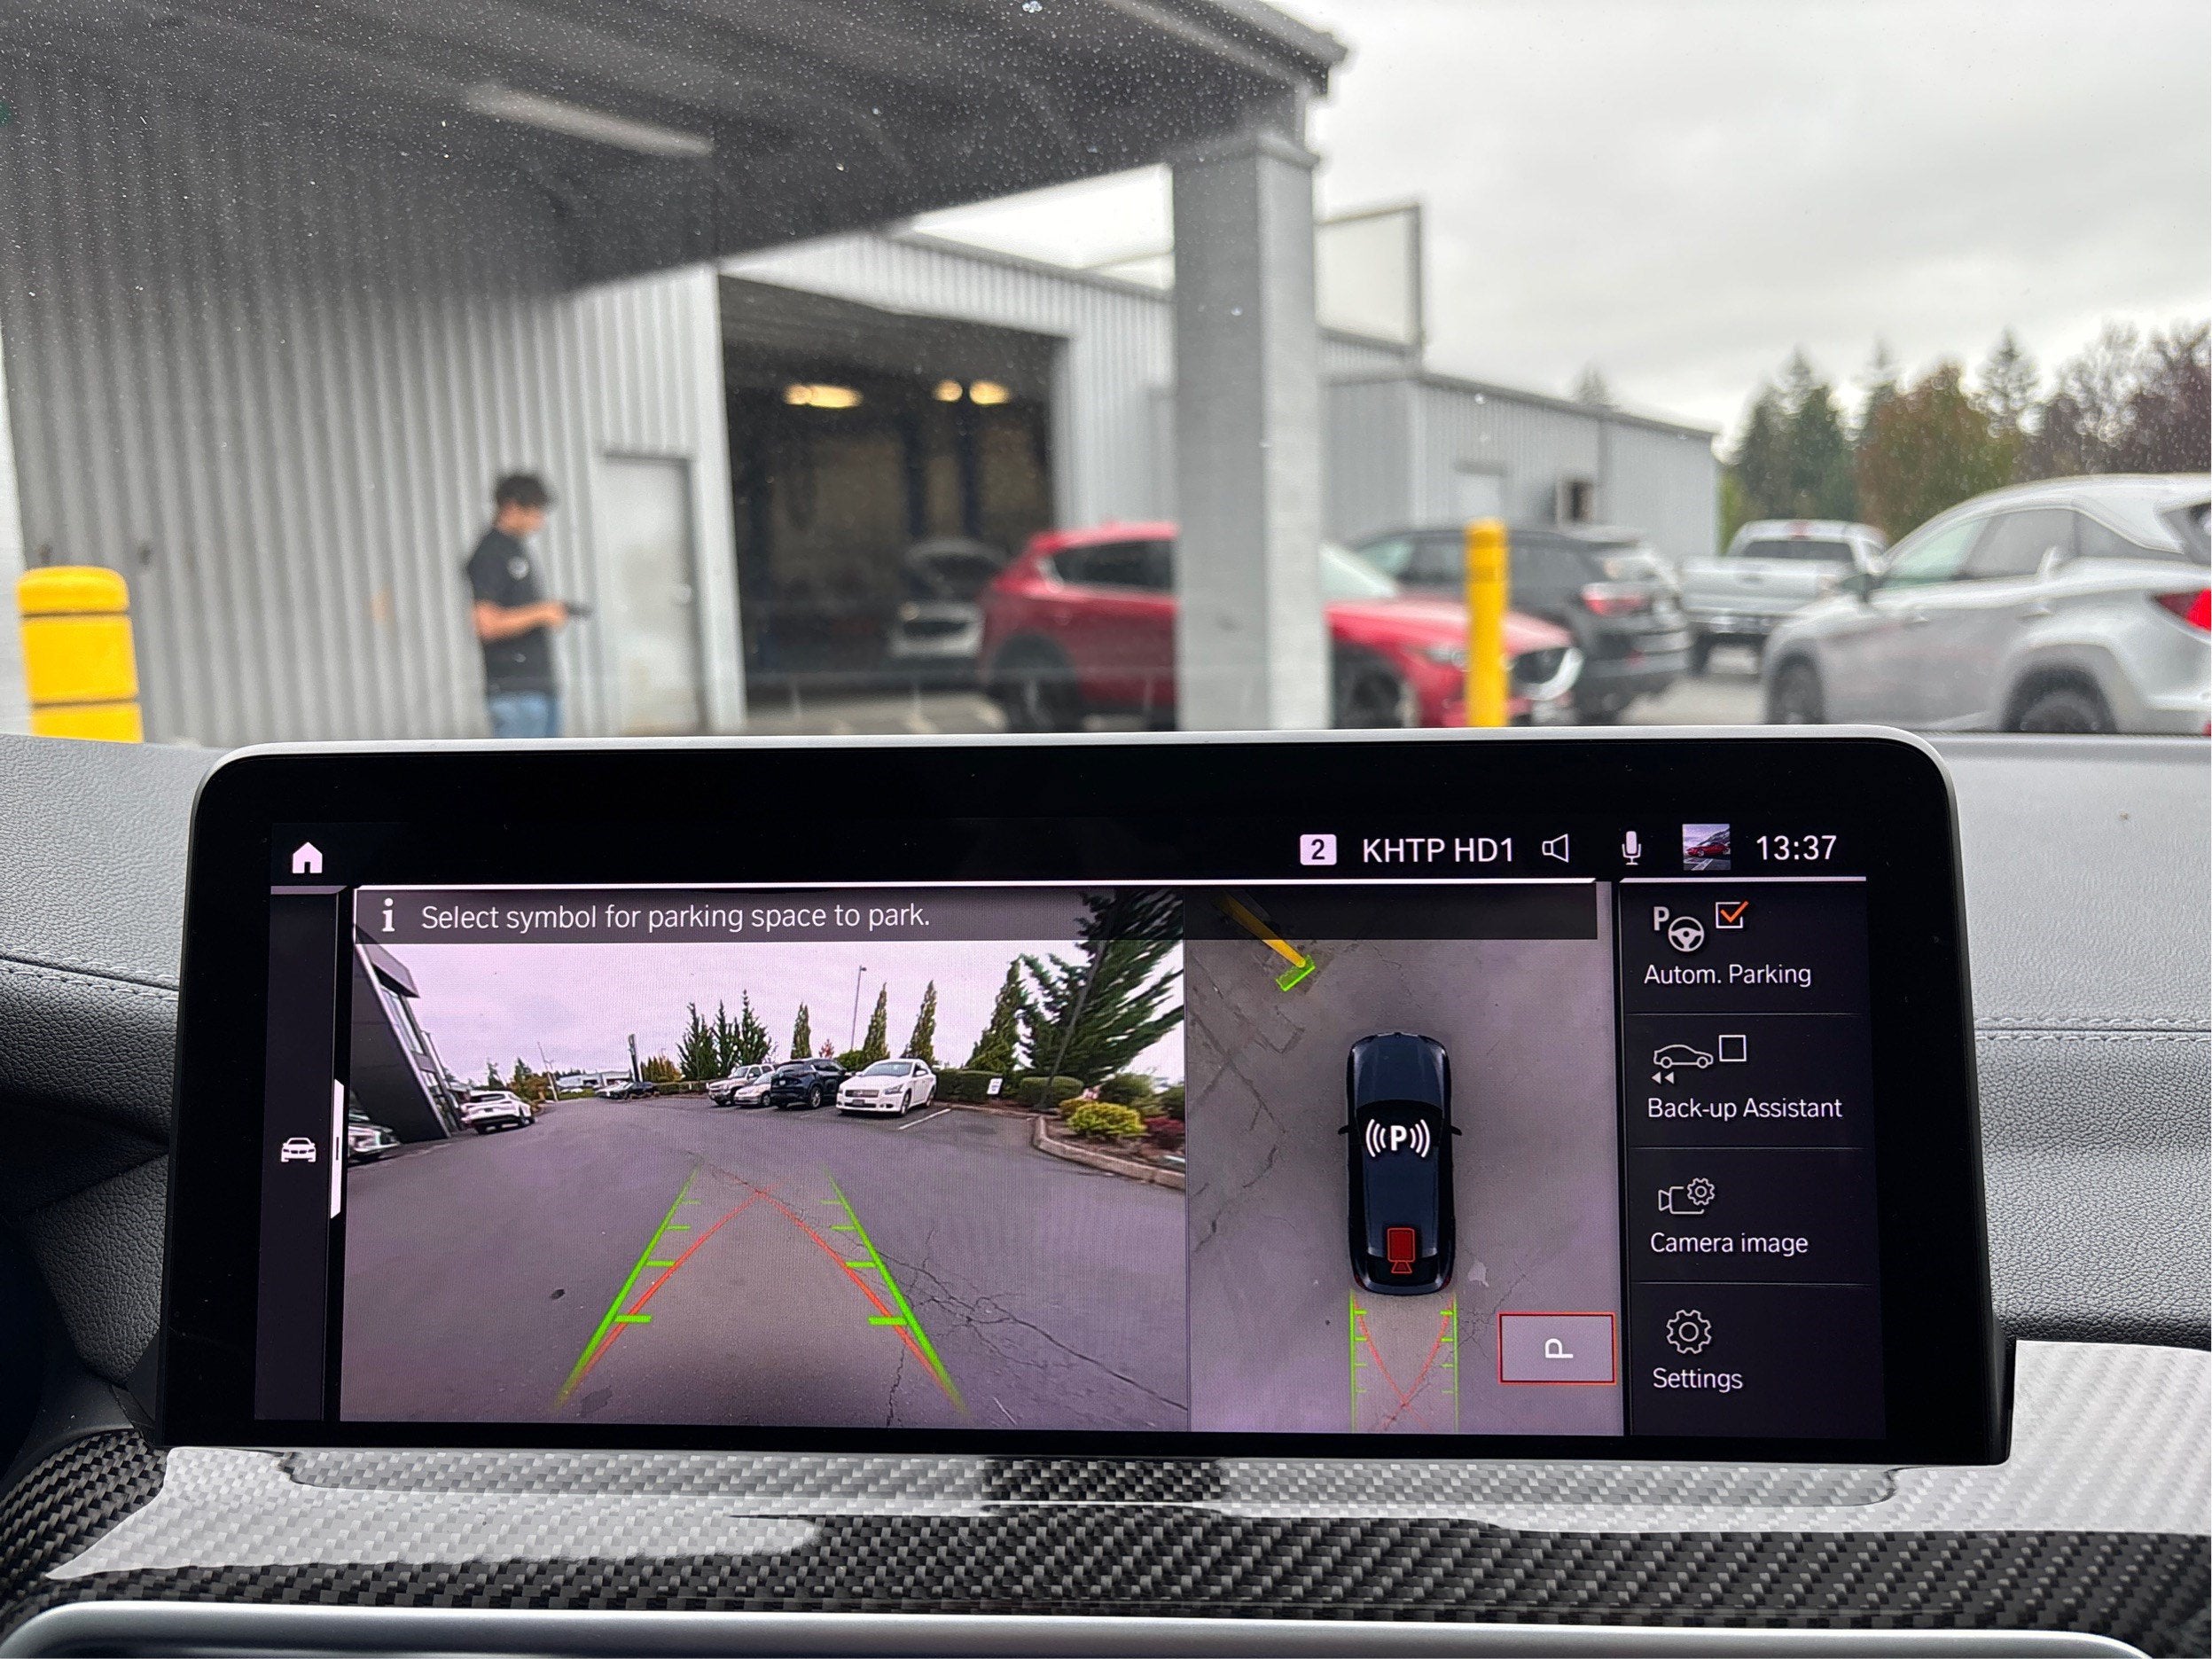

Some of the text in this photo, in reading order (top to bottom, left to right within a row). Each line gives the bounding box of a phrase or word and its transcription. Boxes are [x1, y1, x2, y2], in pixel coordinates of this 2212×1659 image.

[1310, 838, 1325, 860] 2
[1363, 837, 1512, 863] KHTP HD1
[1756, 834, 1837, 861] 13:37
[421, 902, 930, 935] Select symbol for parking space to park.
[1653, 905, 1670, 931] P
[1644, 963, 1811, 988] Autom. Parking
[1648, 1097, 1843, 1122] Back-up Assistant
[1390, 1124, 1408, 1152] P
[1650, 1232, 1809, 1257] Camera image
[1653, 1367, 1743, 1394] Settings
